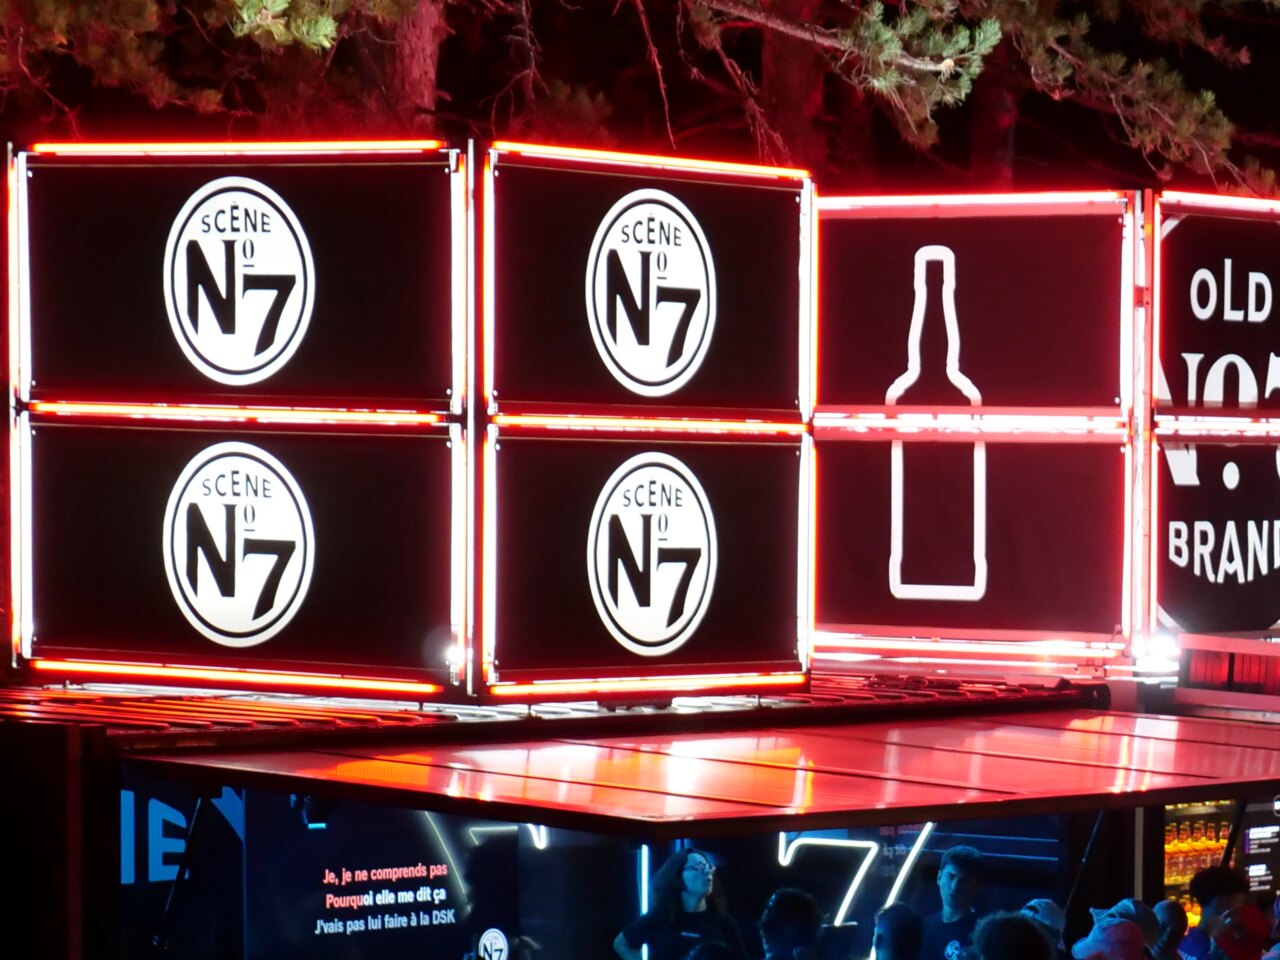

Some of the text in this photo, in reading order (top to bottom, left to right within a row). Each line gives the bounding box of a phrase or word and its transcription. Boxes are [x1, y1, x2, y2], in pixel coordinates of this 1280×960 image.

[1190, 258, 1273, 323] OLD
[341, 867, 352, 886] je
[355, 869, 368, 882] ne
[370, 863, 427, 882] comprends
[429, 864, 448, 880] pas
[326, 886, 446, 909] Pourquoi elle me dit ça
[315, 909, 455, 935] J'vais pas lui faire à la DSK
